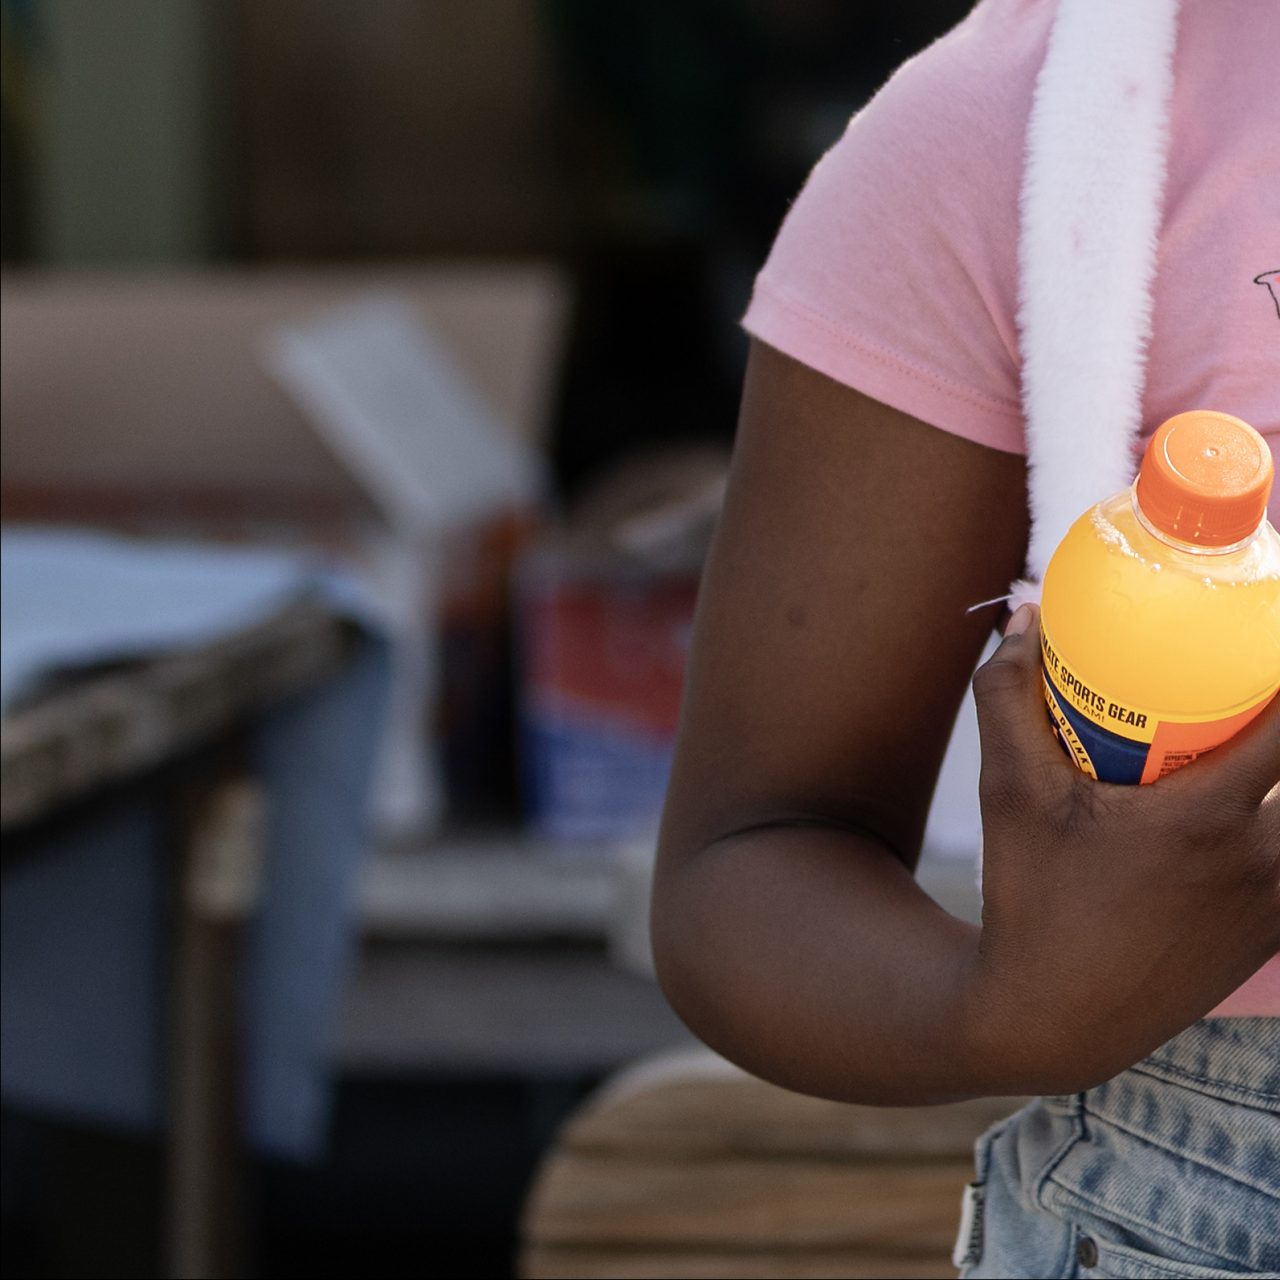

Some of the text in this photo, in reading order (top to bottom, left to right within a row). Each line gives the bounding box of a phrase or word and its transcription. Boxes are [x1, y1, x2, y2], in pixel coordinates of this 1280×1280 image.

[1060, 665, 1106, 713] SPORTS
[1107, 702, 1148, 730] GEAR
[1060, 716, 1090, 765] DRINK
